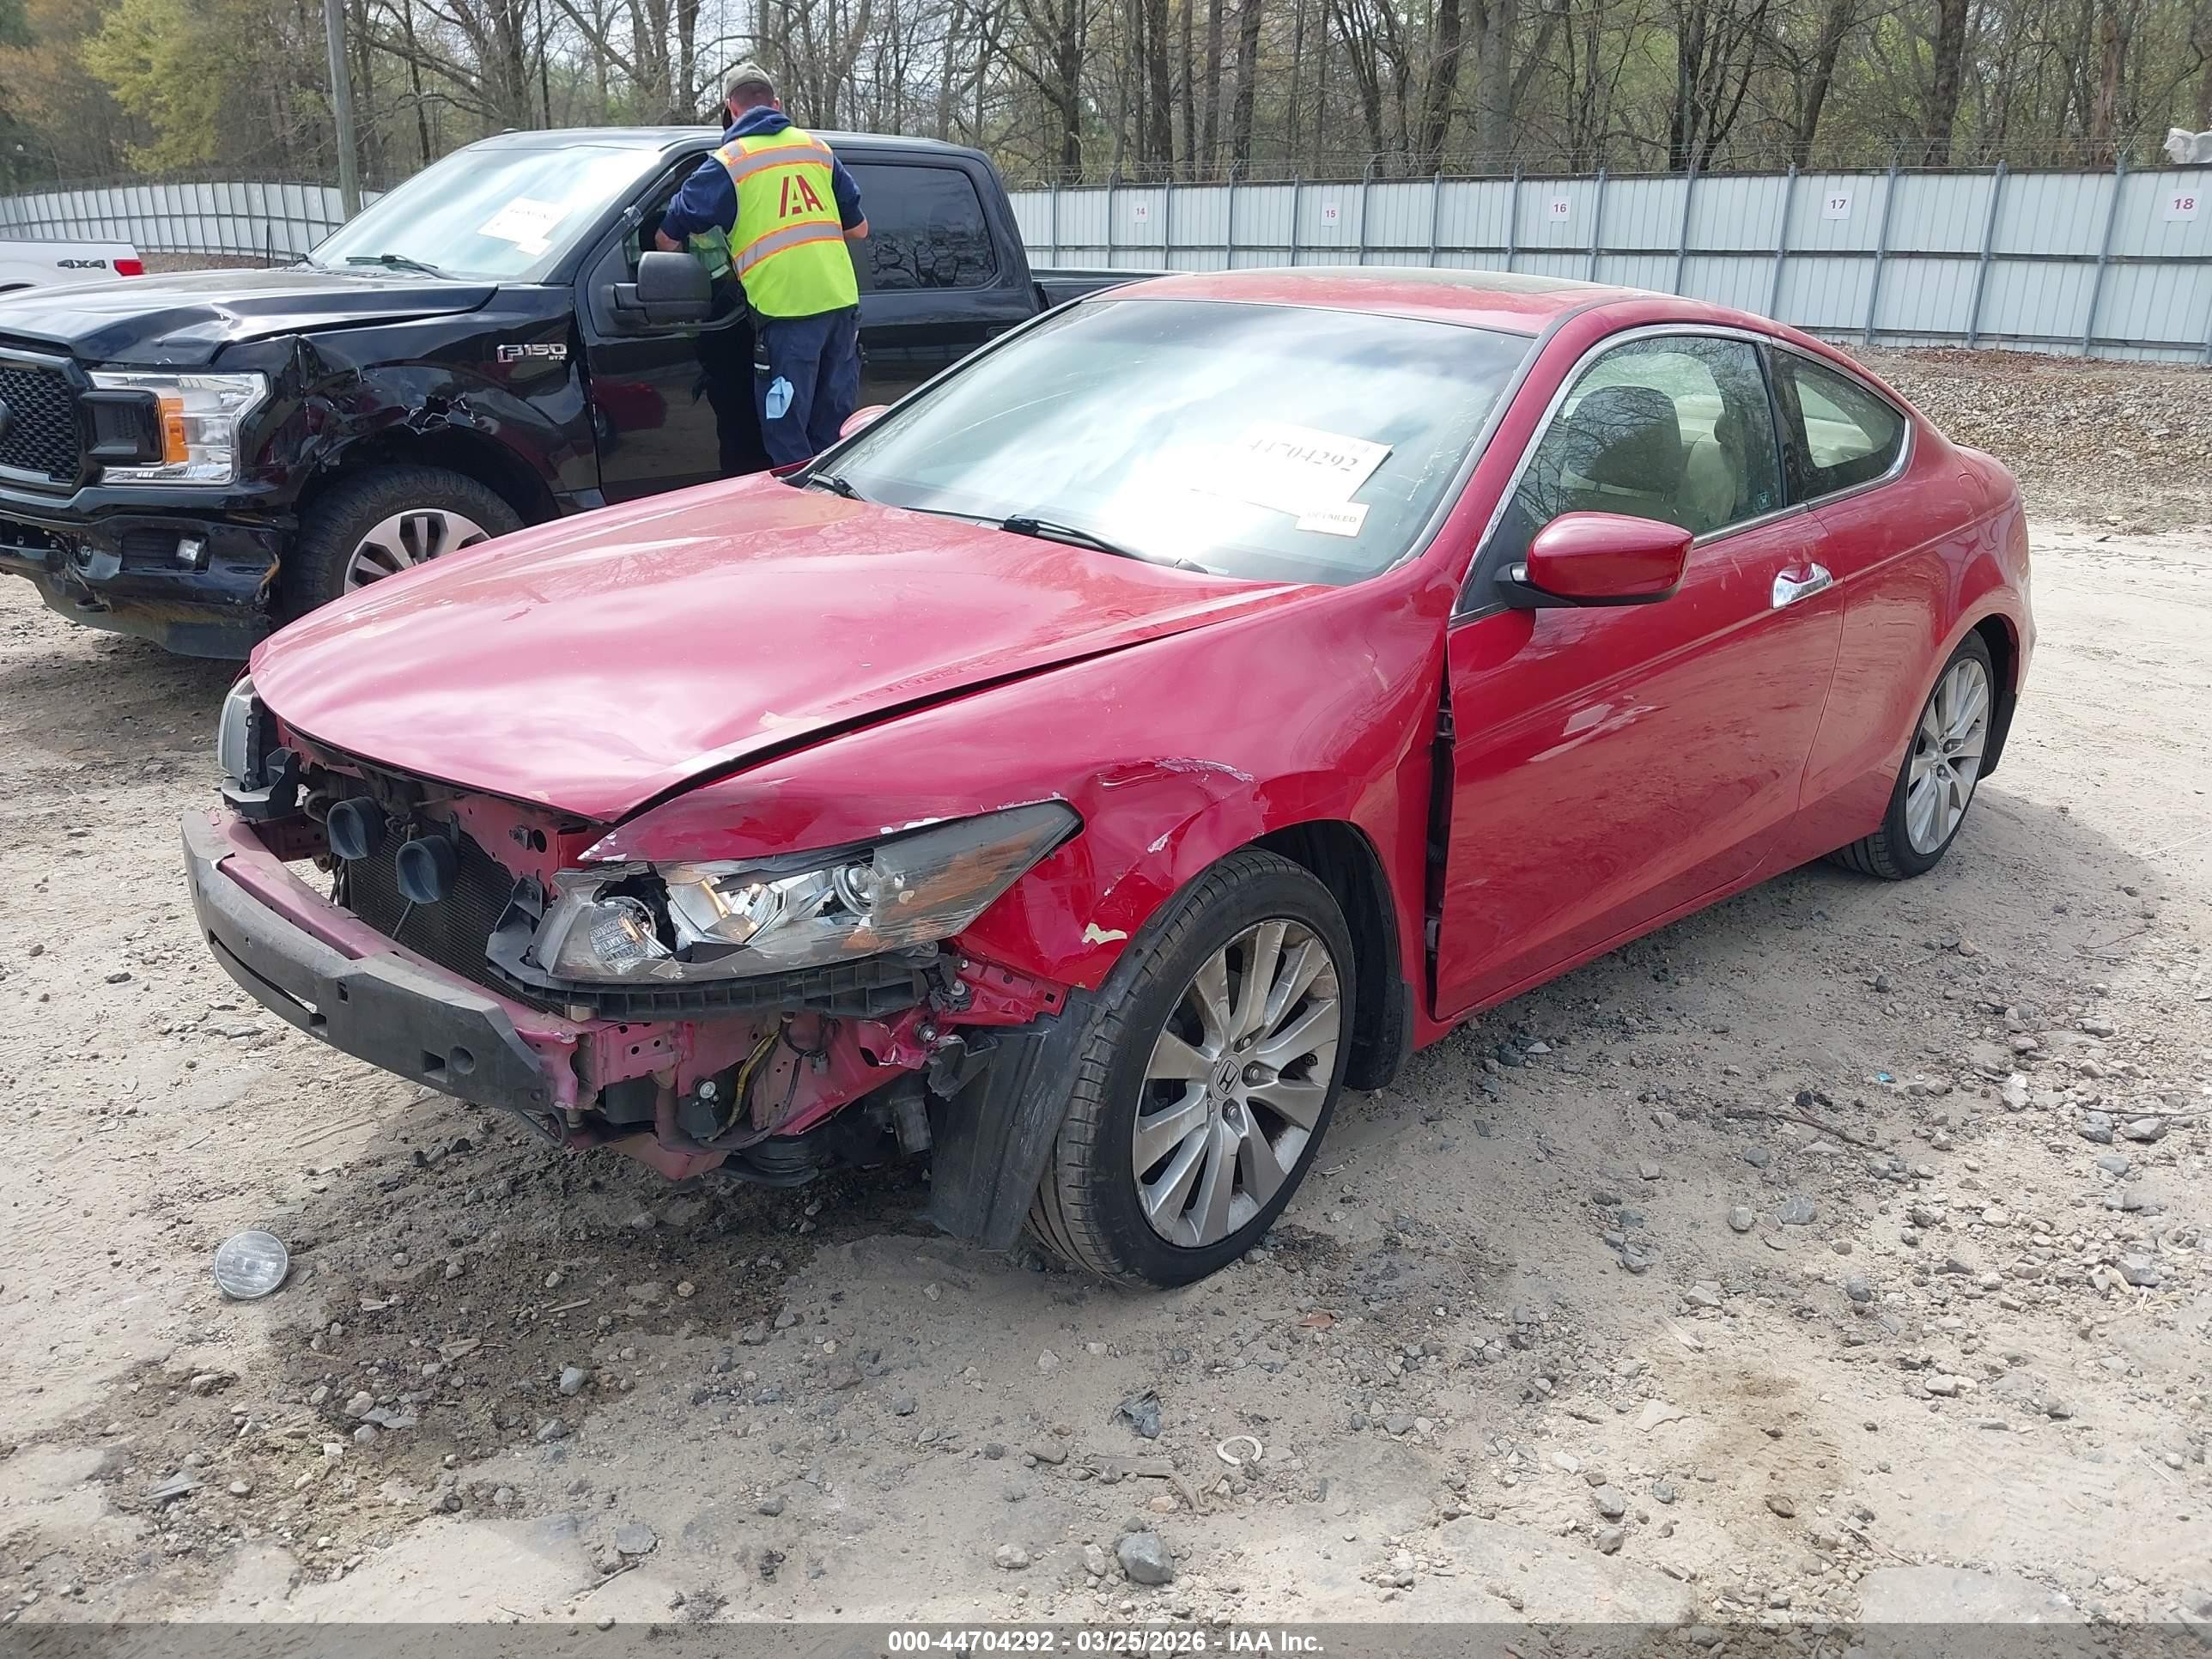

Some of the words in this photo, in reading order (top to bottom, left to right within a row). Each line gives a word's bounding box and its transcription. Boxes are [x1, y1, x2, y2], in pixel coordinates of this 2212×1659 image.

[1553, 203, 1567, 213] 16
[1831, 198, 1847, 210] 17
[2173, 198, 2195, 210] 18
[1326, 209, 1336, 218] 15
